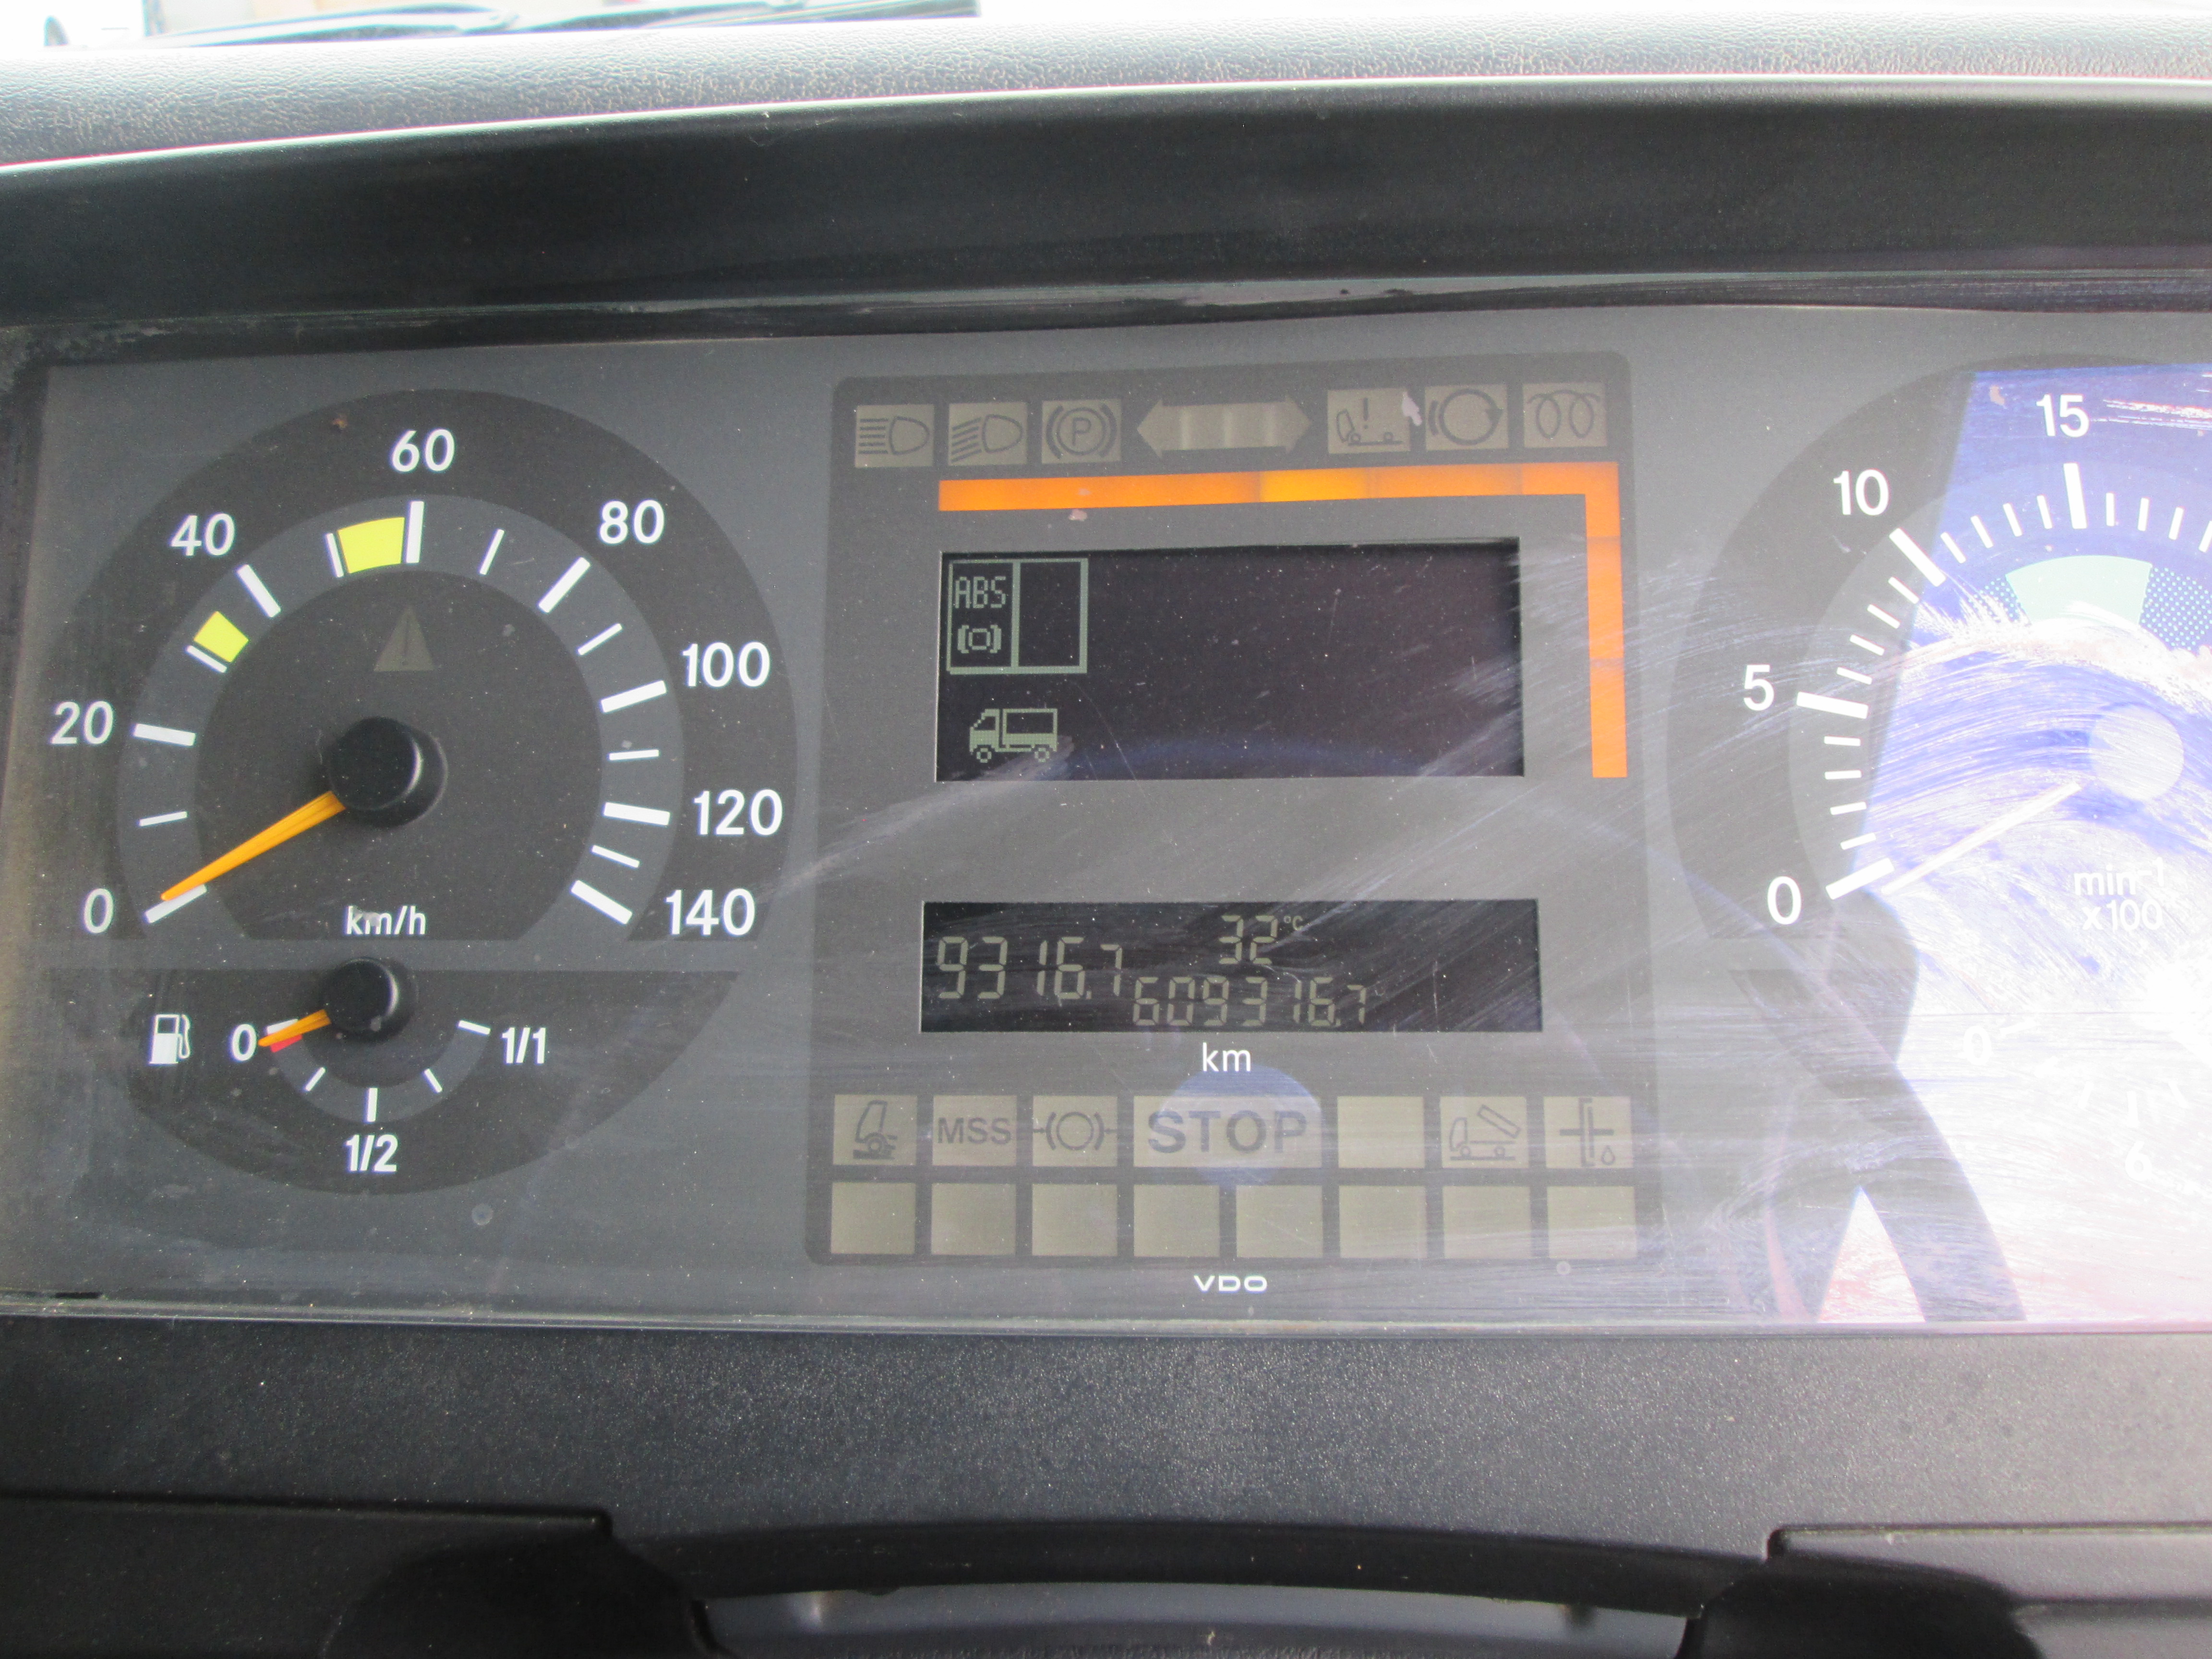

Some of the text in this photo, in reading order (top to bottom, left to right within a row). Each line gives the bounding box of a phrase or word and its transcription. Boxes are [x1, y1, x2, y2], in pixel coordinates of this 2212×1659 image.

[1071, 418, 1092, 445] P
[2036, 393, 2090, 437] 15
[391, 429, 455, 472] 60
[1833, 469, 1889, 516] 10
[170, 513, 235, 557] 40
[599, 500, 665, 544] 80
[955, 576, 1007, 609] ABS
[682, 642, 770, 687] 100
[1743, 664, 1775, 711] 5
[50, 701, 113, 745] 20
[694, 789, 783, 836] 120
[84, 889, 113, 933] 0
[345, 905, 426, 935] km/h
[666, 888, 756, 936] 140
[1767, 876, 1802, 925] 0
[2082, 900, 2164, 931] x100
[1218, 915, 1278, 964] 32
[230, 1024, 257, 1061] 0
[502, 1027, 546, 1064] 1/1
[1202, 1042, 1251, 1072] km
[346, 1134, 398, 1172] 1/2
[938, 1118, 1012, 1145] MSS
[1148, 1110, 1307, 1154] STOP
[1194, 1275, 1268, 1293] VDO
